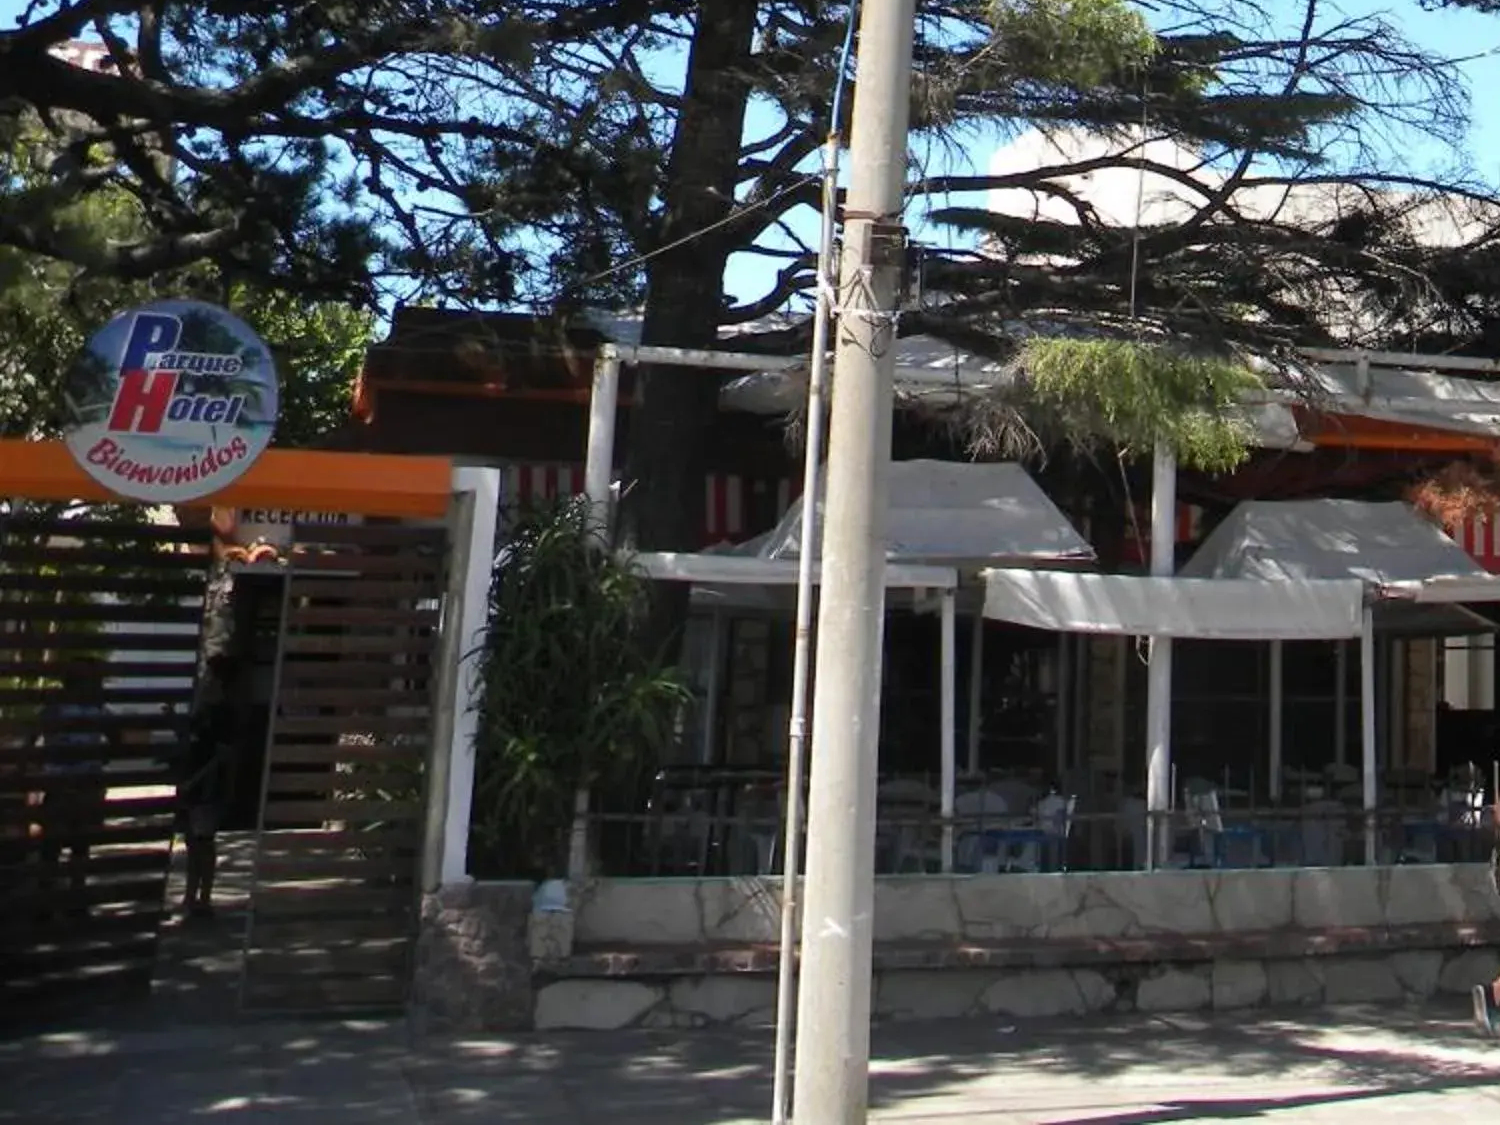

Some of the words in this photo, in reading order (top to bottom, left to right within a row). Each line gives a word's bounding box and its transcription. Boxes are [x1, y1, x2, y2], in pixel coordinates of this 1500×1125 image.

[119, 312, 245, 377] Parque
[108, 369, 246, 434] Hotel
[87, 435, 249, 486] Bienvenidos
